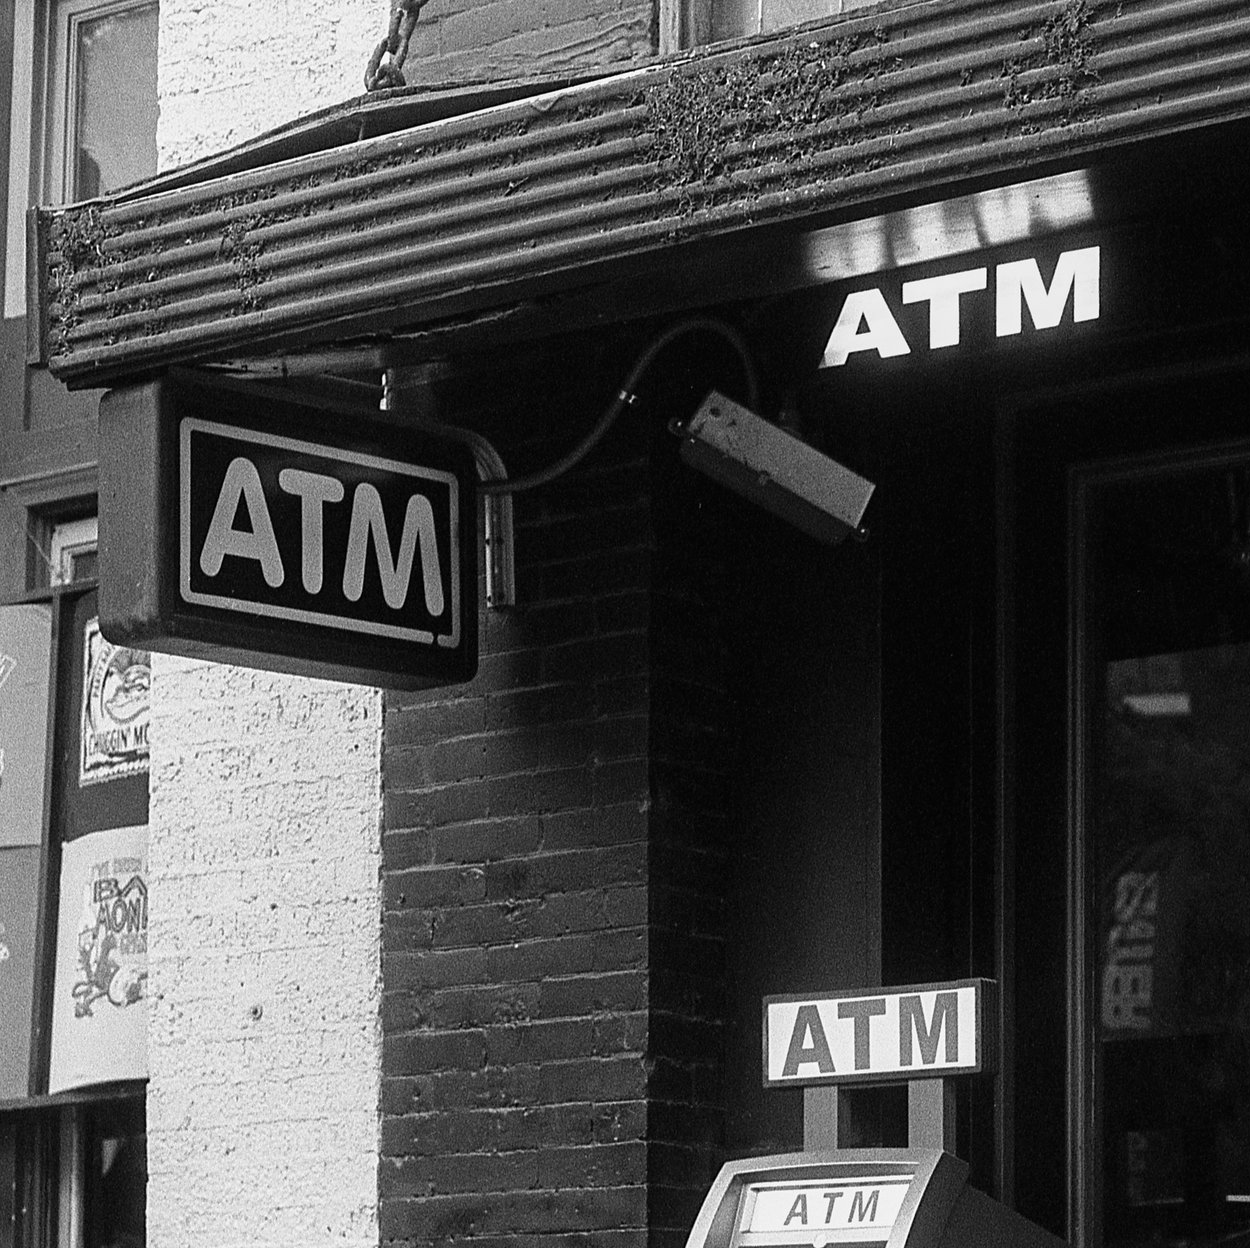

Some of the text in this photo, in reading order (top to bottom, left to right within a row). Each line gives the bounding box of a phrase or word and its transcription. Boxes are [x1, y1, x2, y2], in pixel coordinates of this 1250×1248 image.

[818, 245, 1101, 369] ATM
[199, 456, 445, 617] ATM
[781, 991, 959, 1078] ATM
[783, 1189, 880, 1226] ATM
